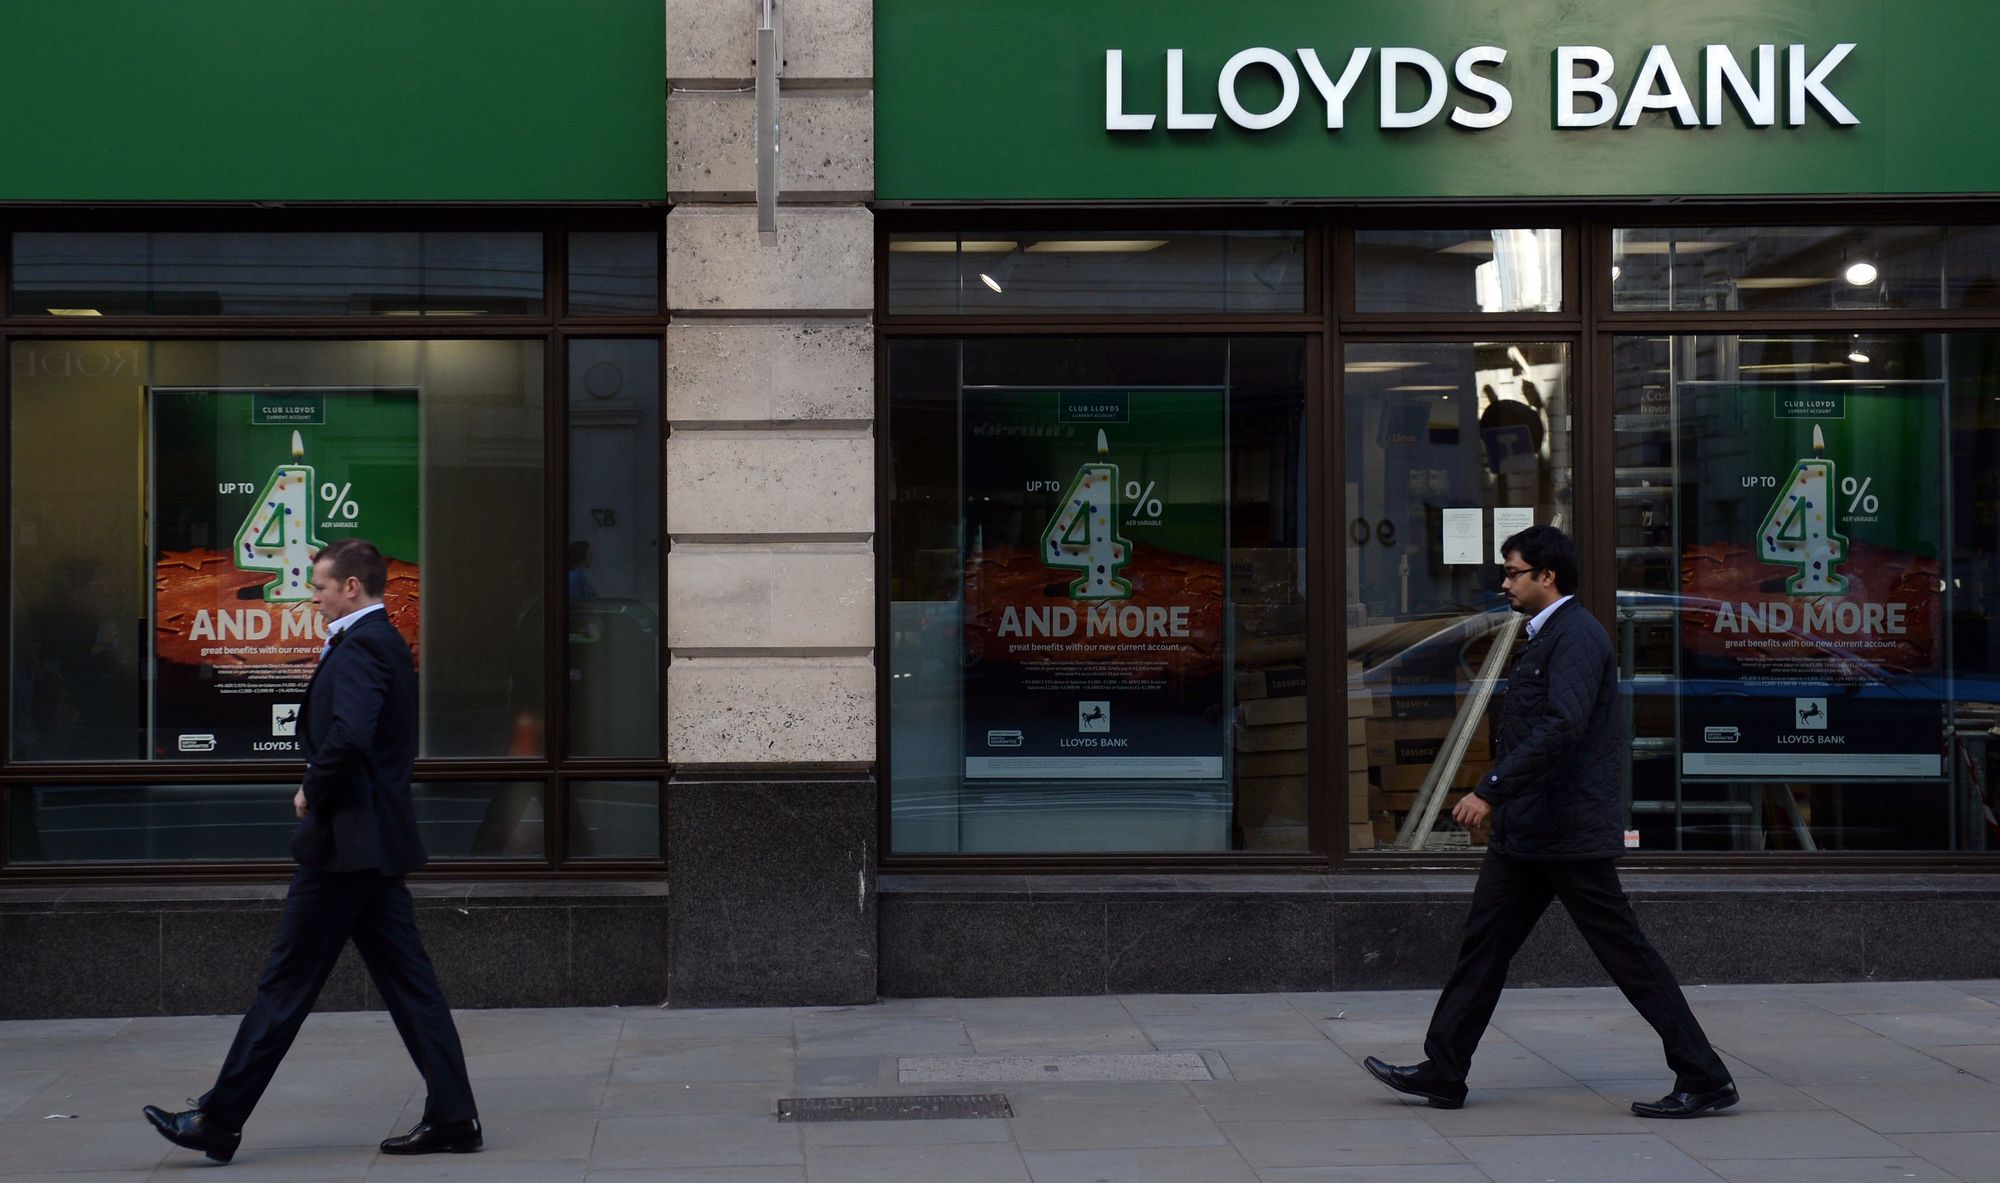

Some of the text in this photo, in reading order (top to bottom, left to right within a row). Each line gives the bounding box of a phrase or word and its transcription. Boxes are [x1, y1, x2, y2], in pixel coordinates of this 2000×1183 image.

[1105, 43, 1861, 131] LLOYDS BANK
[262, 406, 315, 414] CLUB LLOYDS
[1026, 462, 1163, 601] UP TO 4 %
[1742, 457, 1879, 597] UP TO 4 %
[218, 464, 359, 603] UP TO 4 %
[997, 606, 1190, 638] AND MORE
[1714, 602, 1907, 634] AND MORE
[189, 609, 327, 641] AND MO
[1008, 643, 1031, 652] great
[1031, 642, 1064, 651] benefits
[1065, 642, 1083, 651] with
[1117, 643, 1146, 651] current
[1147, 643, 1179, 651] account
[1725, 640, 1747, 649] great
[1747, 639, 1780, 648] benefits
[1781, 639, 1799, 648] with
[1834, 640, 1863, 648] current
[1864, 640, 1896, 648] account
[200, 646, 223, 656] great
[224, 645, 258, 654] benefits
[259, 646, 278, 654] with
[293, 646, 311, 654] new
[1271, 679, 1306, 689] tessera
[1060, 738, 1128, 747] LLOYDS BANK
[1777, 735, 1845, 744] LLOYDS BANK
[253, 742, 292, 751] LLOYDS
[1401, 747, 1433, 757] tessera
